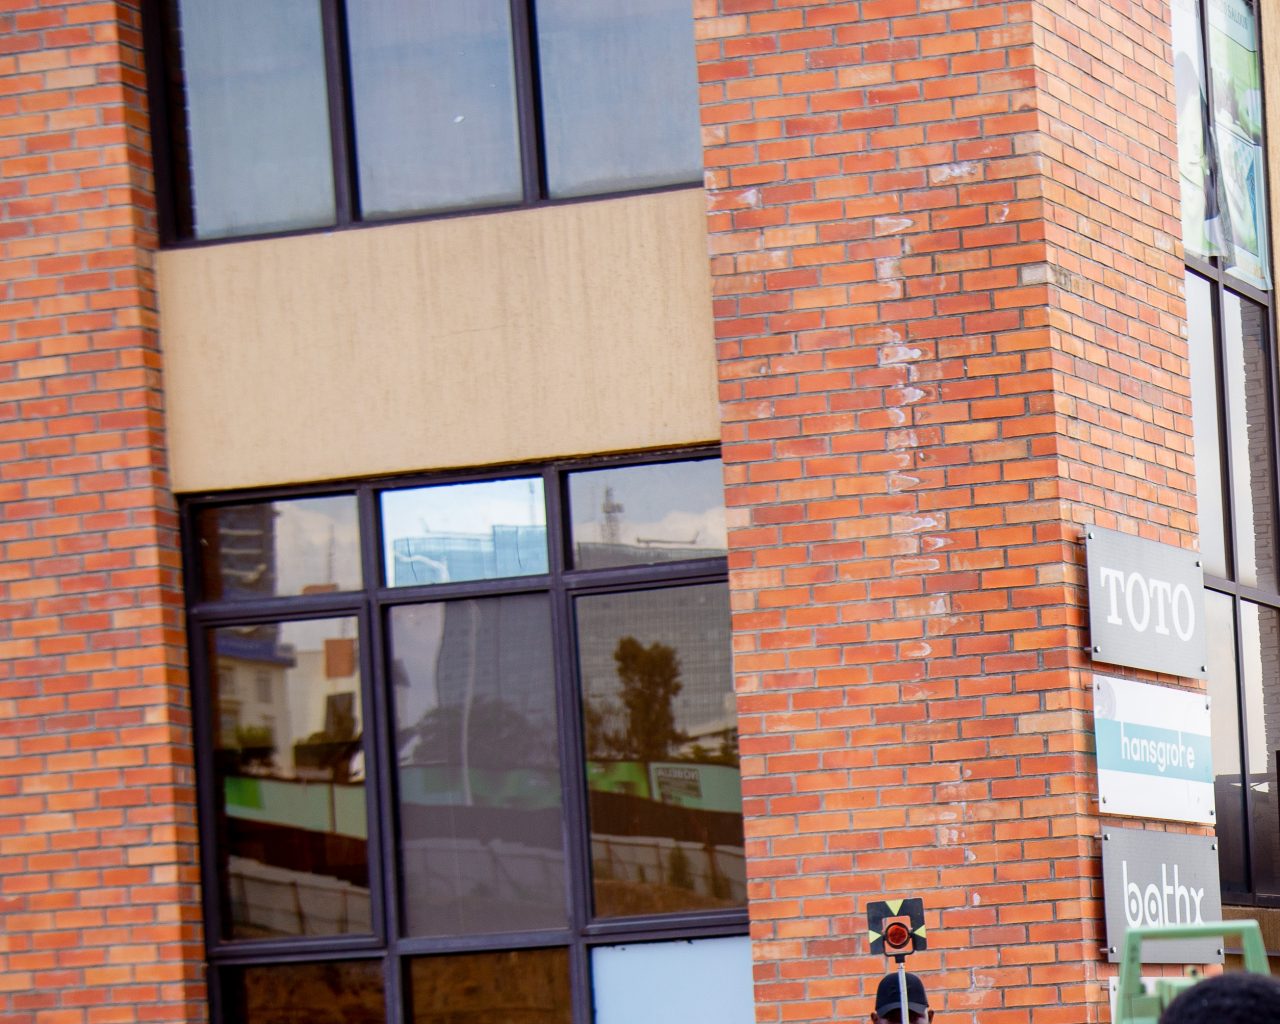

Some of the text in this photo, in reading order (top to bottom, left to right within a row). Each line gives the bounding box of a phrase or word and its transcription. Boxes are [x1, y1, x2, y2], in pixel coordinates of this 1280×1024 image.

[1100, 567, 1195, 641] TOTO
[1120, 720, 1195, 772] hansgrohe
[1122, 860, 1204, 928] bathx
